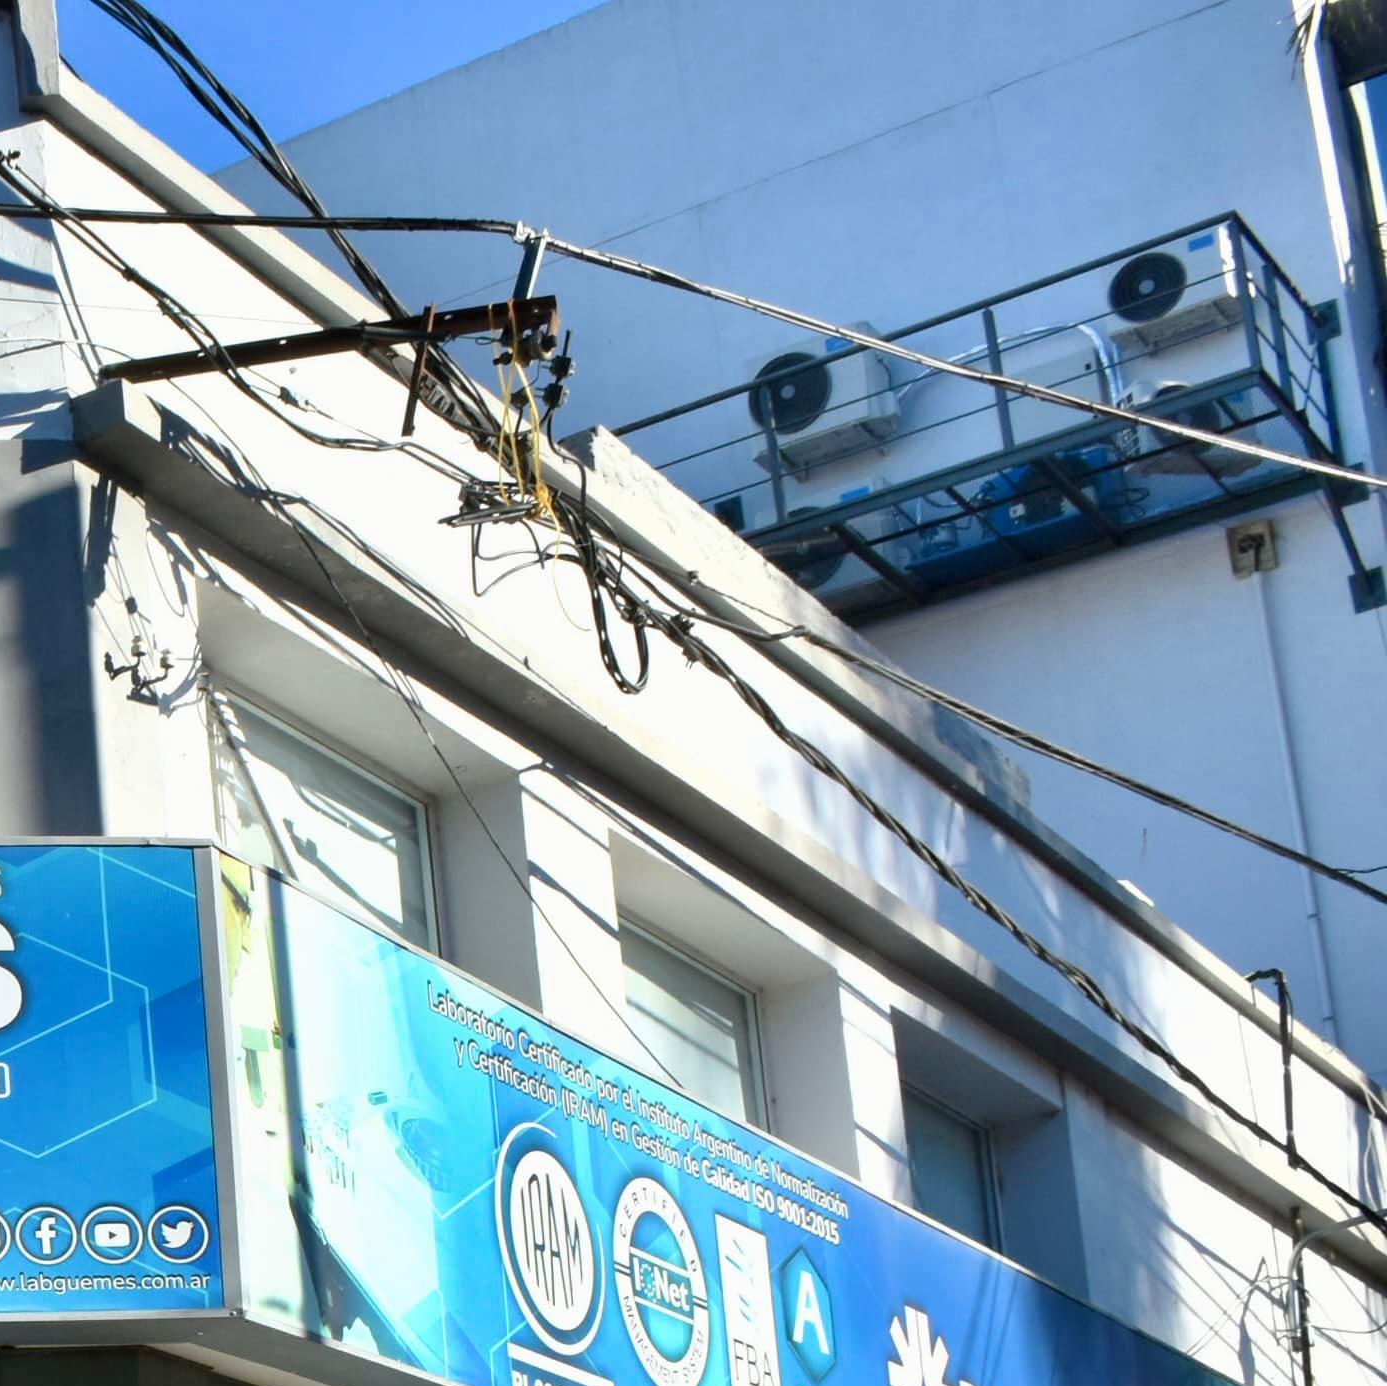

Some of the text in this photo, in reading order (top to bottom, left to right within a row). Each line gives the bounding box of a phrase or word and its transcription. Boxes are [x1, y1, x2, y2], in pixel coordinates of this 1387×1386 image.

[427, 981, 849, 1221] Laboratorio Certificado por el Instituto Argentino de Normalización
[454, 1039, 839, 1246] y Certificación (IRAM) en Gestión de Calidad ISO 9001:2015
[520, 1173, 583, 1311] IRAM
